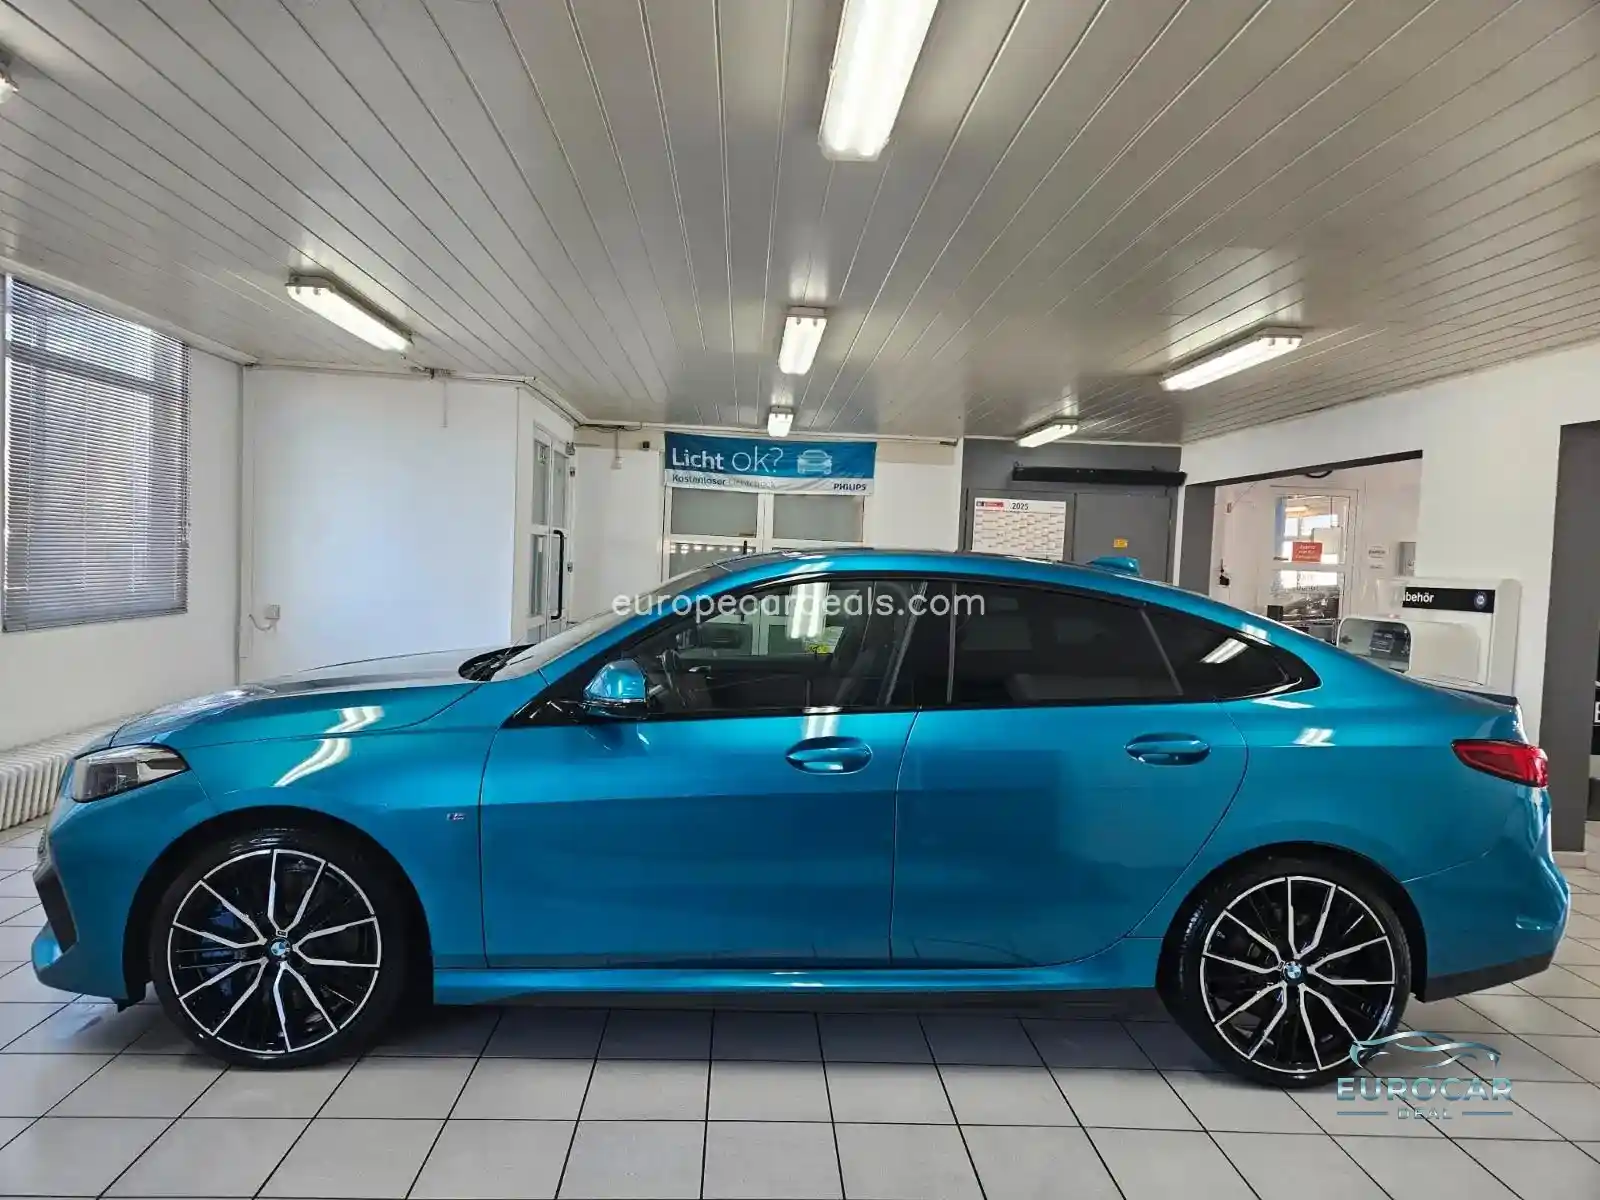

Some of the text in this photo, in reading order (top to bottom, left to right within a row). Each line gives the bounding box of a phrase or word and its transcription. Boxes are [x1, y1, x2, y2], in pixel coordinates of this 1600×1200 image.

[672, 445, 783, 473] Licht ok?
[672, 474, 726, 486] Kostenloser
[833, 483, 867, 491] PHILIPS
[1012, 502, 1029, 511] 2025
